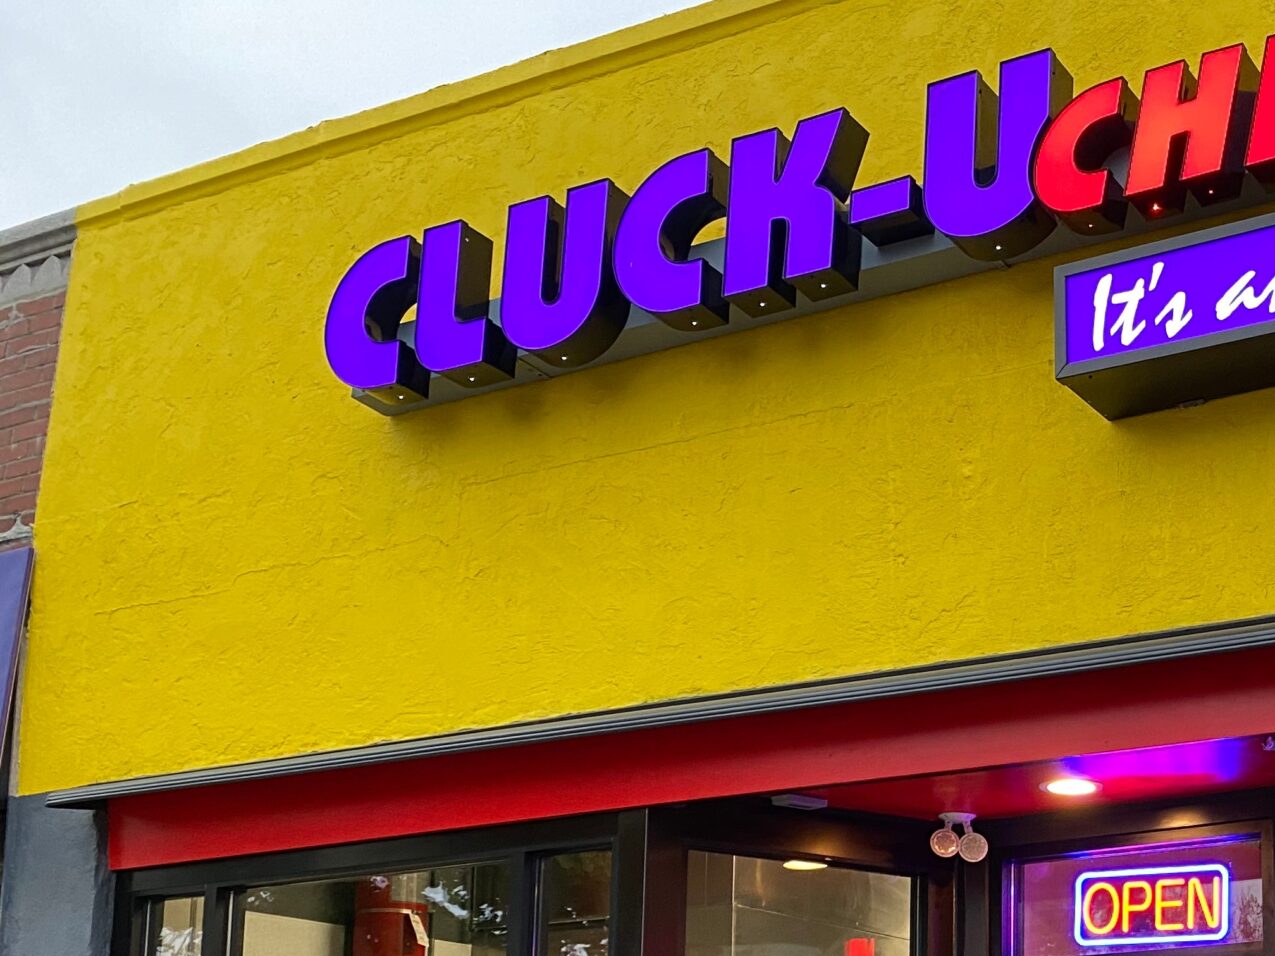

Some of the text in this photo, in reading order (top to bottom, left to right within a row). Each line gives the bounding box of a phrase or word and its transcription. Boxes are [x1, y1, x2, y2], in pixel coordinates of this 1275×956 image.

[324, 47, 1054, 390] CLUCK-U
[1092, 261, 1193, 352] It's
[1082, 875, 1222, 936] OPEN
